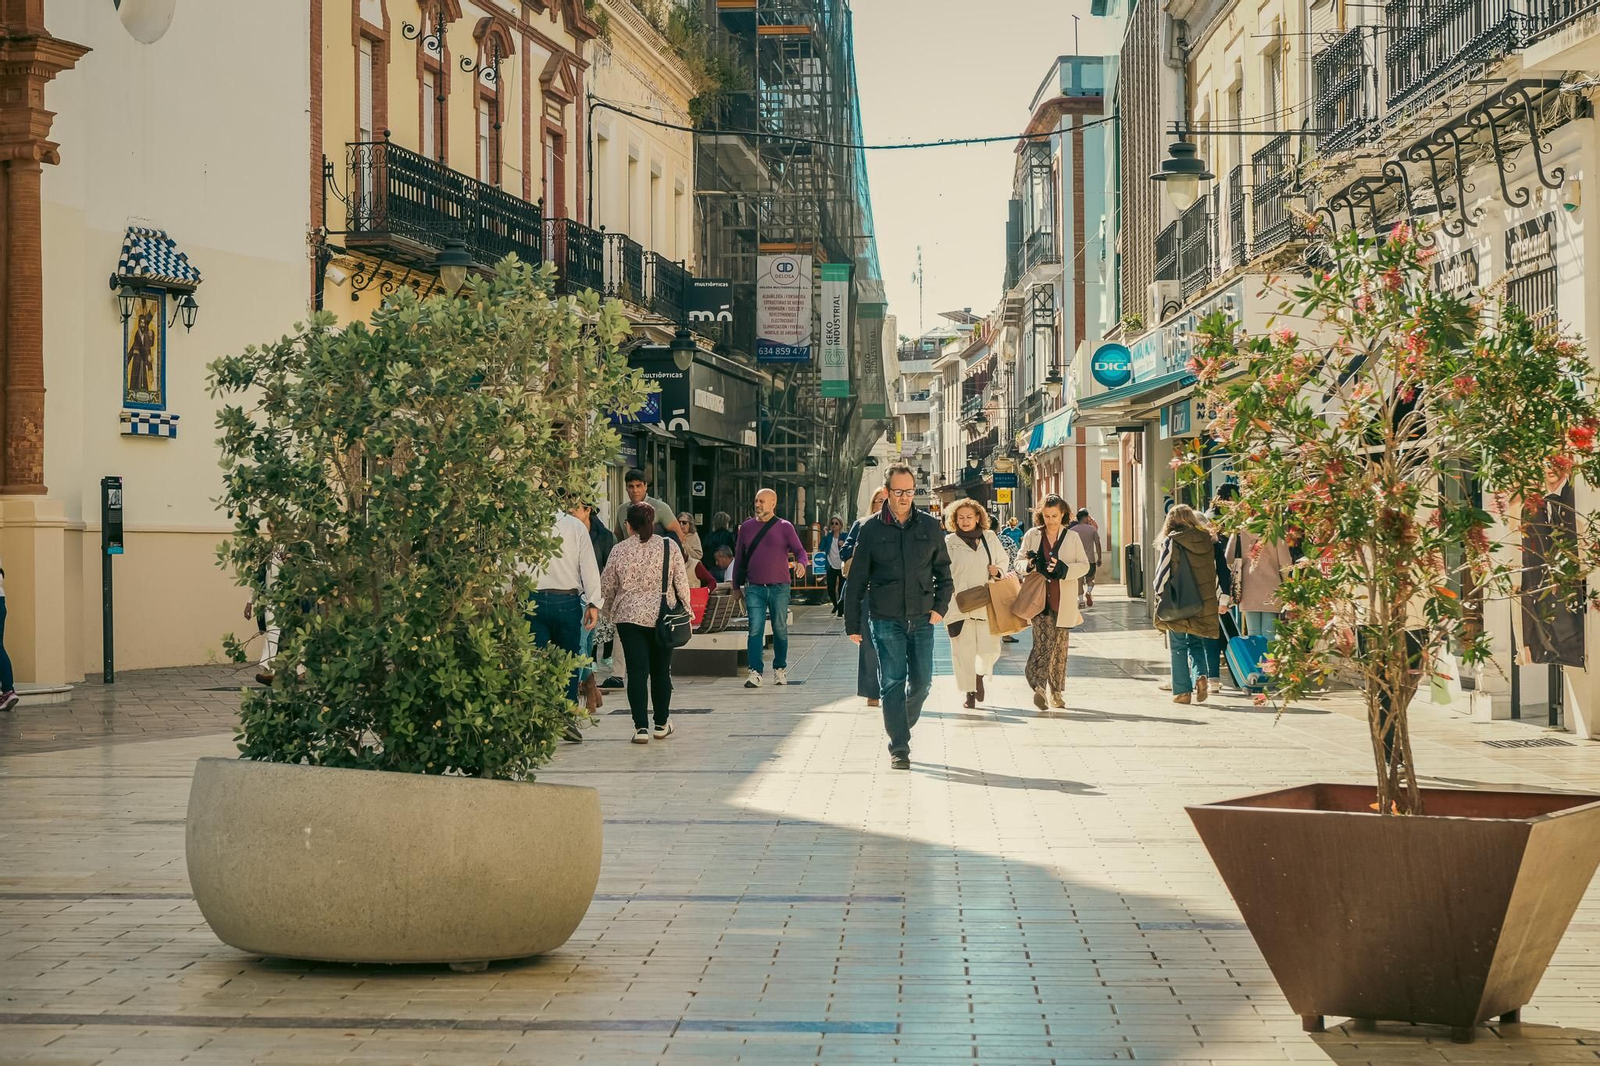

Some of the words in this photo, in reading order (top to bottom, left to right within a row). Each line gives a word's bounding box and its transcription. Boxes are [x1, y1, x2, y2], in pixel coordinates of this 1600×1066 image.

[833, 294, 841, 346] INDUSTRIAL
[826, 321, 834, 346] GEKO
[758, 347, 773, 355] 634
[775, 347, 790, 355] 859
[792, 347, 808, 355] 477
[1094, 362, 1132, 371] DIGI
